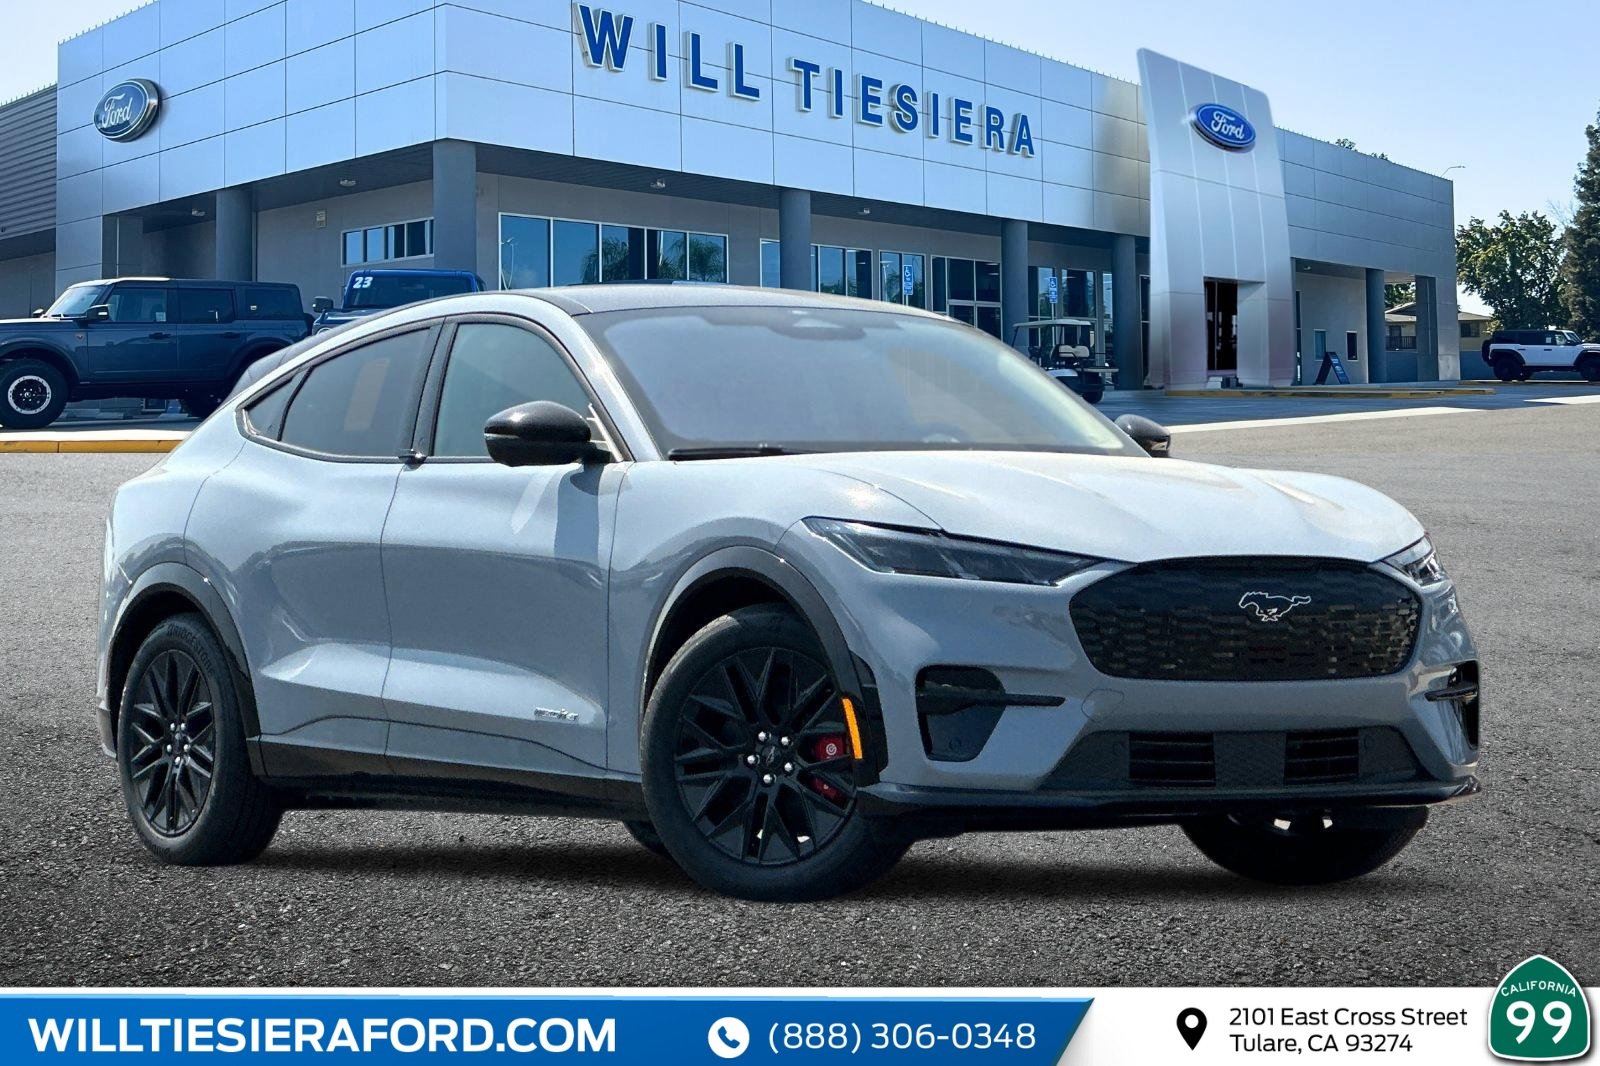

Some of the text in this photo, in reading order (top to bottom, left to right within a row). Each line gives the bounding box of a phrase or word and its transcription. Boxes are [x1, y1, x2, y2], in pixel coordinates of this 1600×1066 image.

[575, 3, 1035, 157] WILL TIESIERA
[102, 93, 133, 128] Ford
[1211, 111, 1245, 139] Ford
[353, 276, 374, 289] 23
